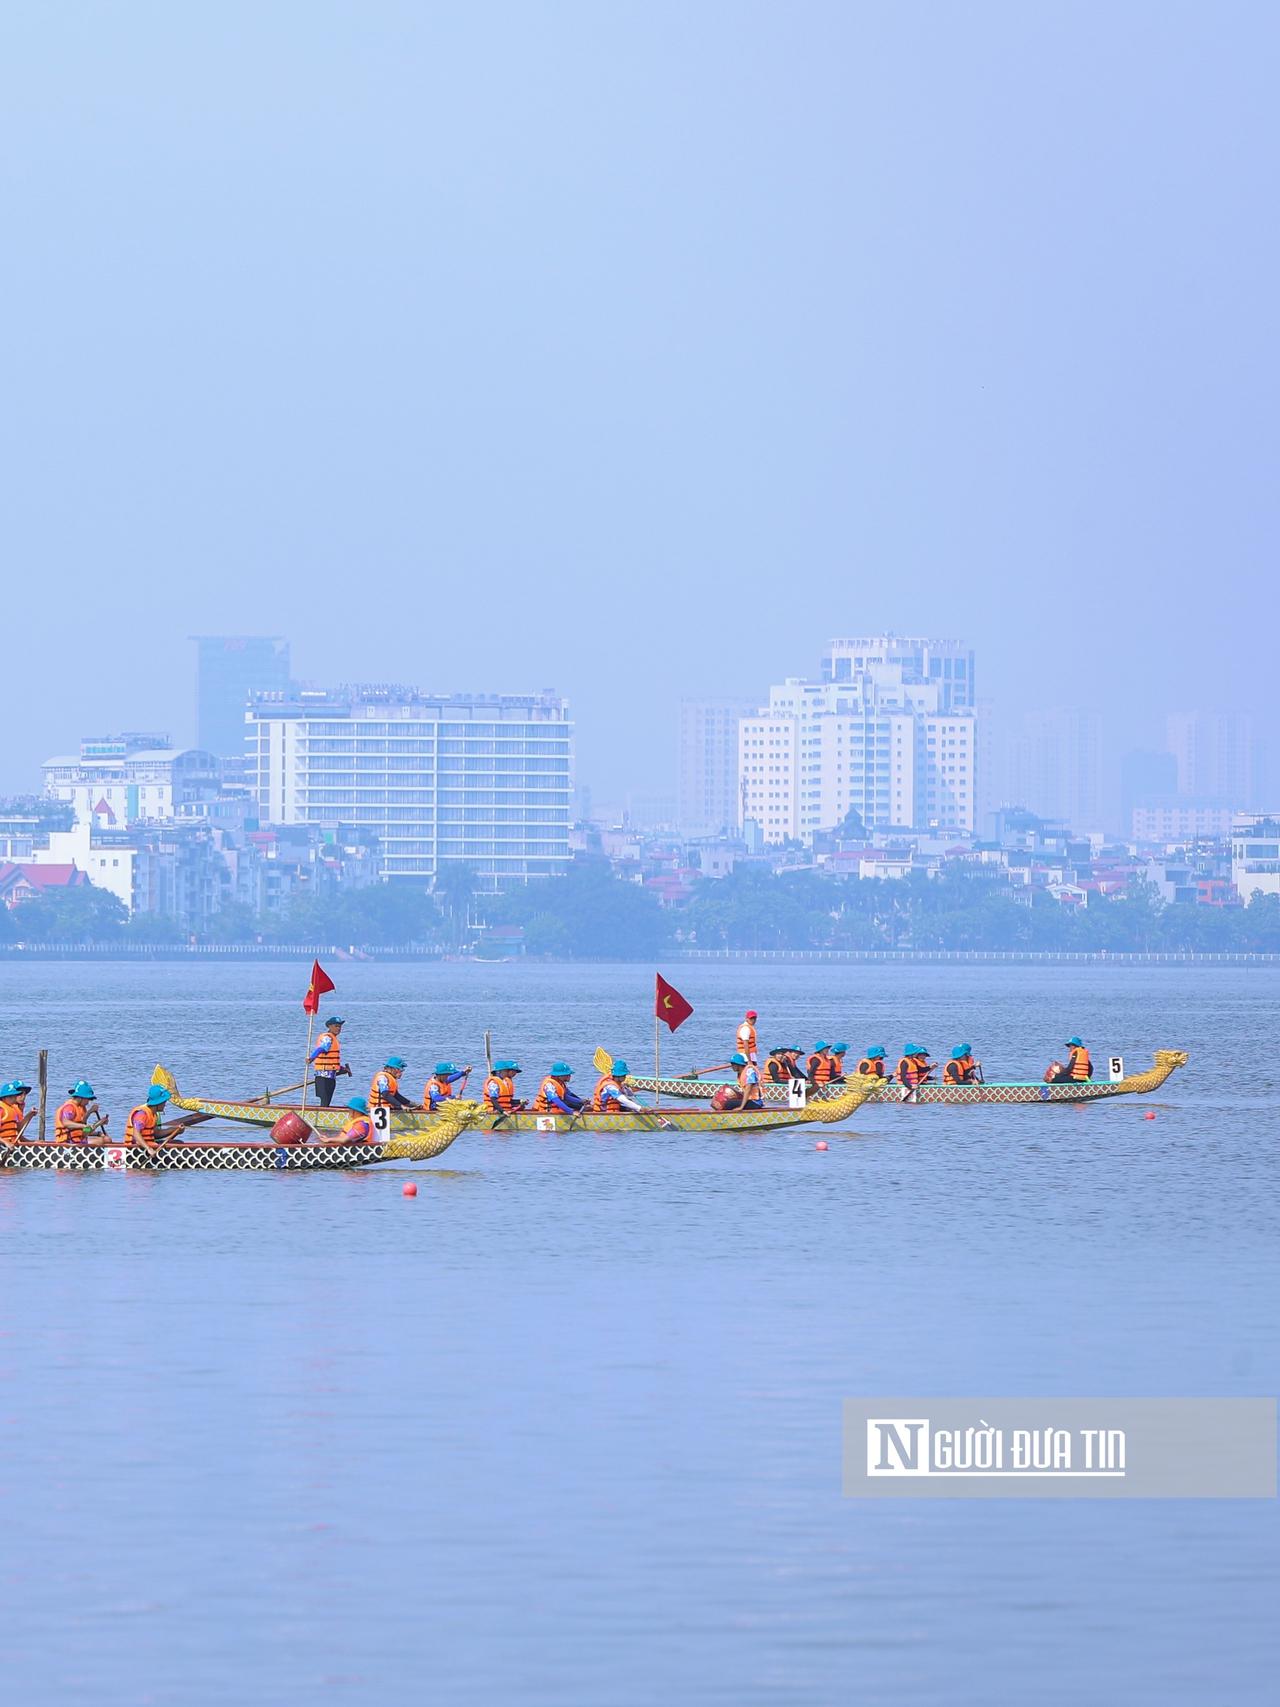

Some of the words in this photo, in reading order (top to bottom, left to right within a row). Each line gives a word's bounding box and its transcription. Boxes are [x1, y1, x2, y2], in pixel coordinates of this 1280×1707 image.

[223, 639, 246, 650] 789
[1111, 1058, 1121, 1073] 5
[792, 1079, 803, 1097] 4
[374, 1107, 387, 1130] 3
